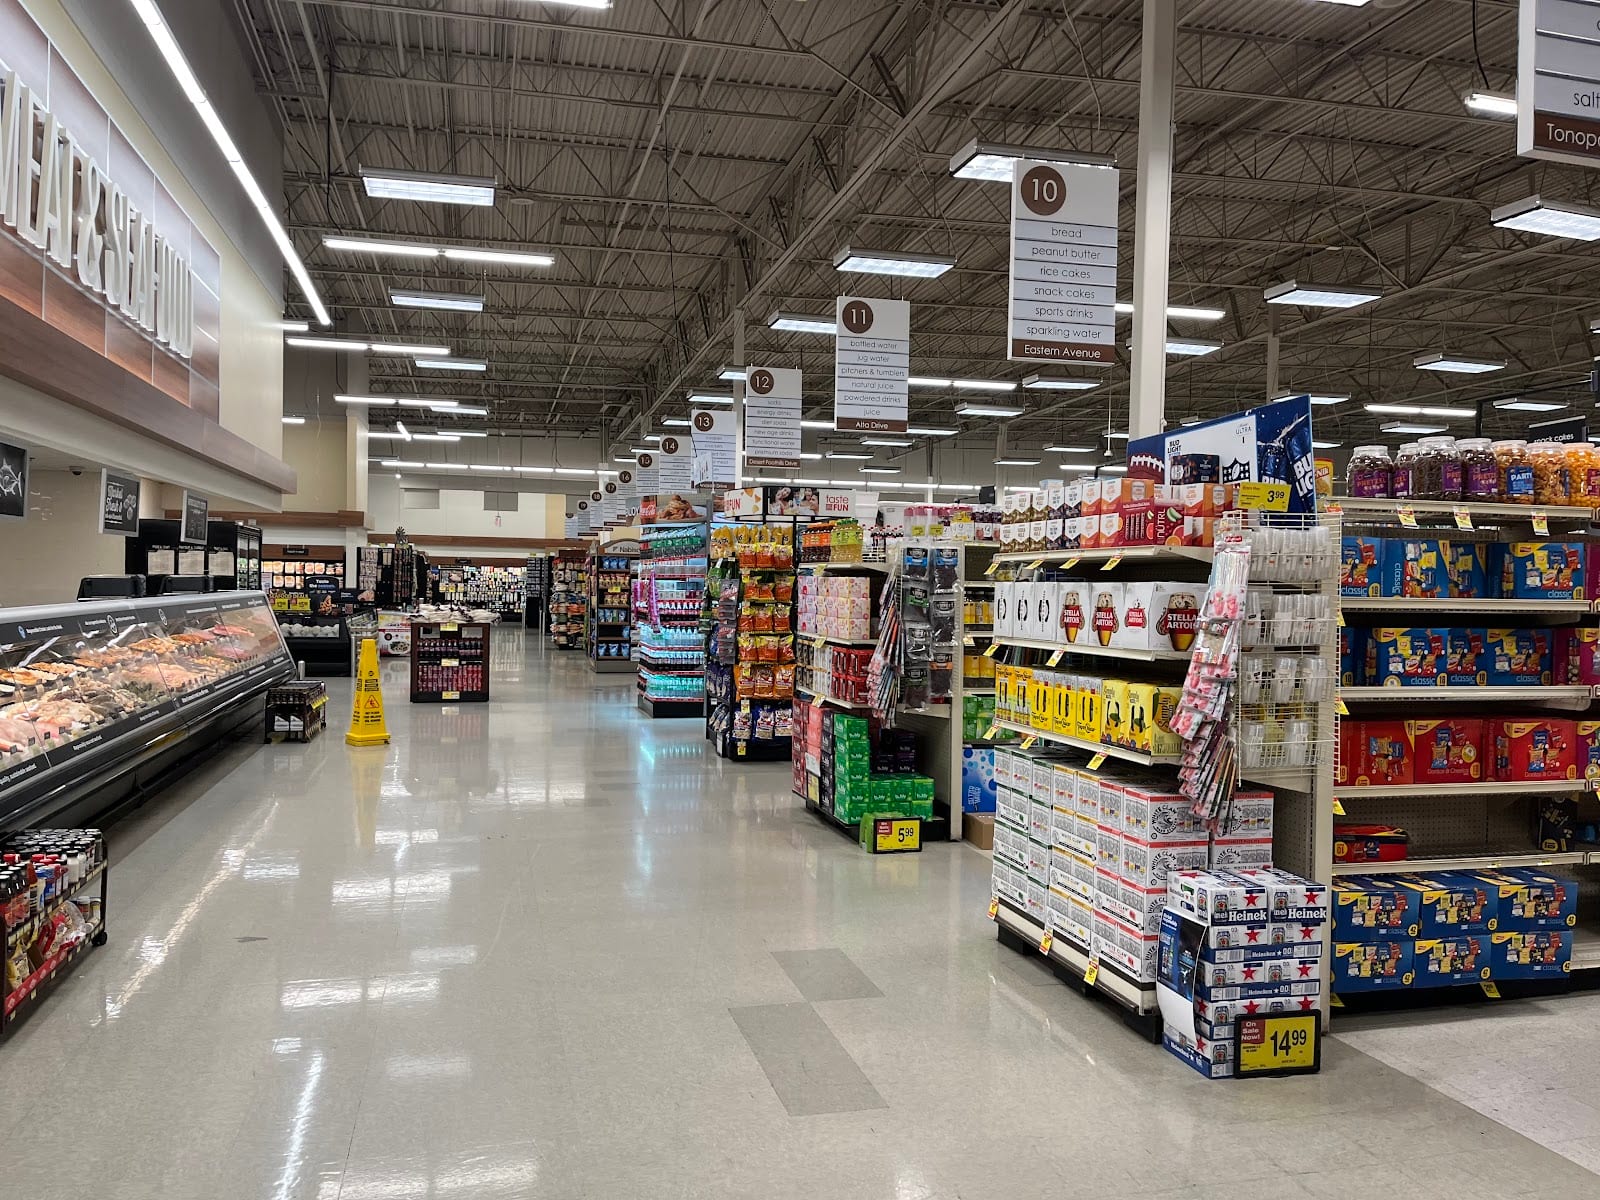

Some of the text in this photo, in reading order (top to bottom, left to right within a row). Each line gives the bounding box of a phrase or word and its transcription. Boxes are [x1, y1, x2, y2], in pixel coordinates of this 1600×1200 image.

[1032, 178, 1058, 202] 10
[1052, 228, 1082, 238] bread
[1032, 246, 1100, 260] peanut butter
[77, 157, 102, 292] &
[103, 183, 193, 359] SEAFOOD
[1040, 266, 1090, 279] rice cakes
[1034, 286, 1095, 299] snack cakes
[852, 309, 866, 324] 11
[1035, 307, 1093, 319] sports drinks
[1026, 326, 1100, 338] sparkling water
[850, 340, 876, 348] bottled
[1024, 345, 1100, 358] Eastern Avenue
[857, 354, 868, 362] jug
[841, 367, 868, 375] pitchers
[756, 376, 769, 387] 12
[877, 382, 893, 390] juice
[844, 394, 880, 402] powdered
[864, 408, 880, 416] juice
[699, 417, 709, 426] 13
[1236, 426, 1252, 435] ULTRA
[1554, 433, 1574, 441] cakes
[666, 442, 675, 450] 14
[1169, 439, 1179, 447] BUD
[1167, 445, 1181, 454] LIGHT
[826, 495, 848, 503] taste
[1341, 586, 1367, 595] classic
[1548, 590, 1572, 598] classic
[1096, 612, 1113, 620] STELLA
[1168, 613, 1196, 622] STELLA
[1411, 676, 1436, 685] classic
[1451, 674, 1475, 682] classic
[1516, 674, 1540, 682] classic
[1228, 910, 1266, 922] Heinek
[1288, 909, 1326, 919] Heinek
